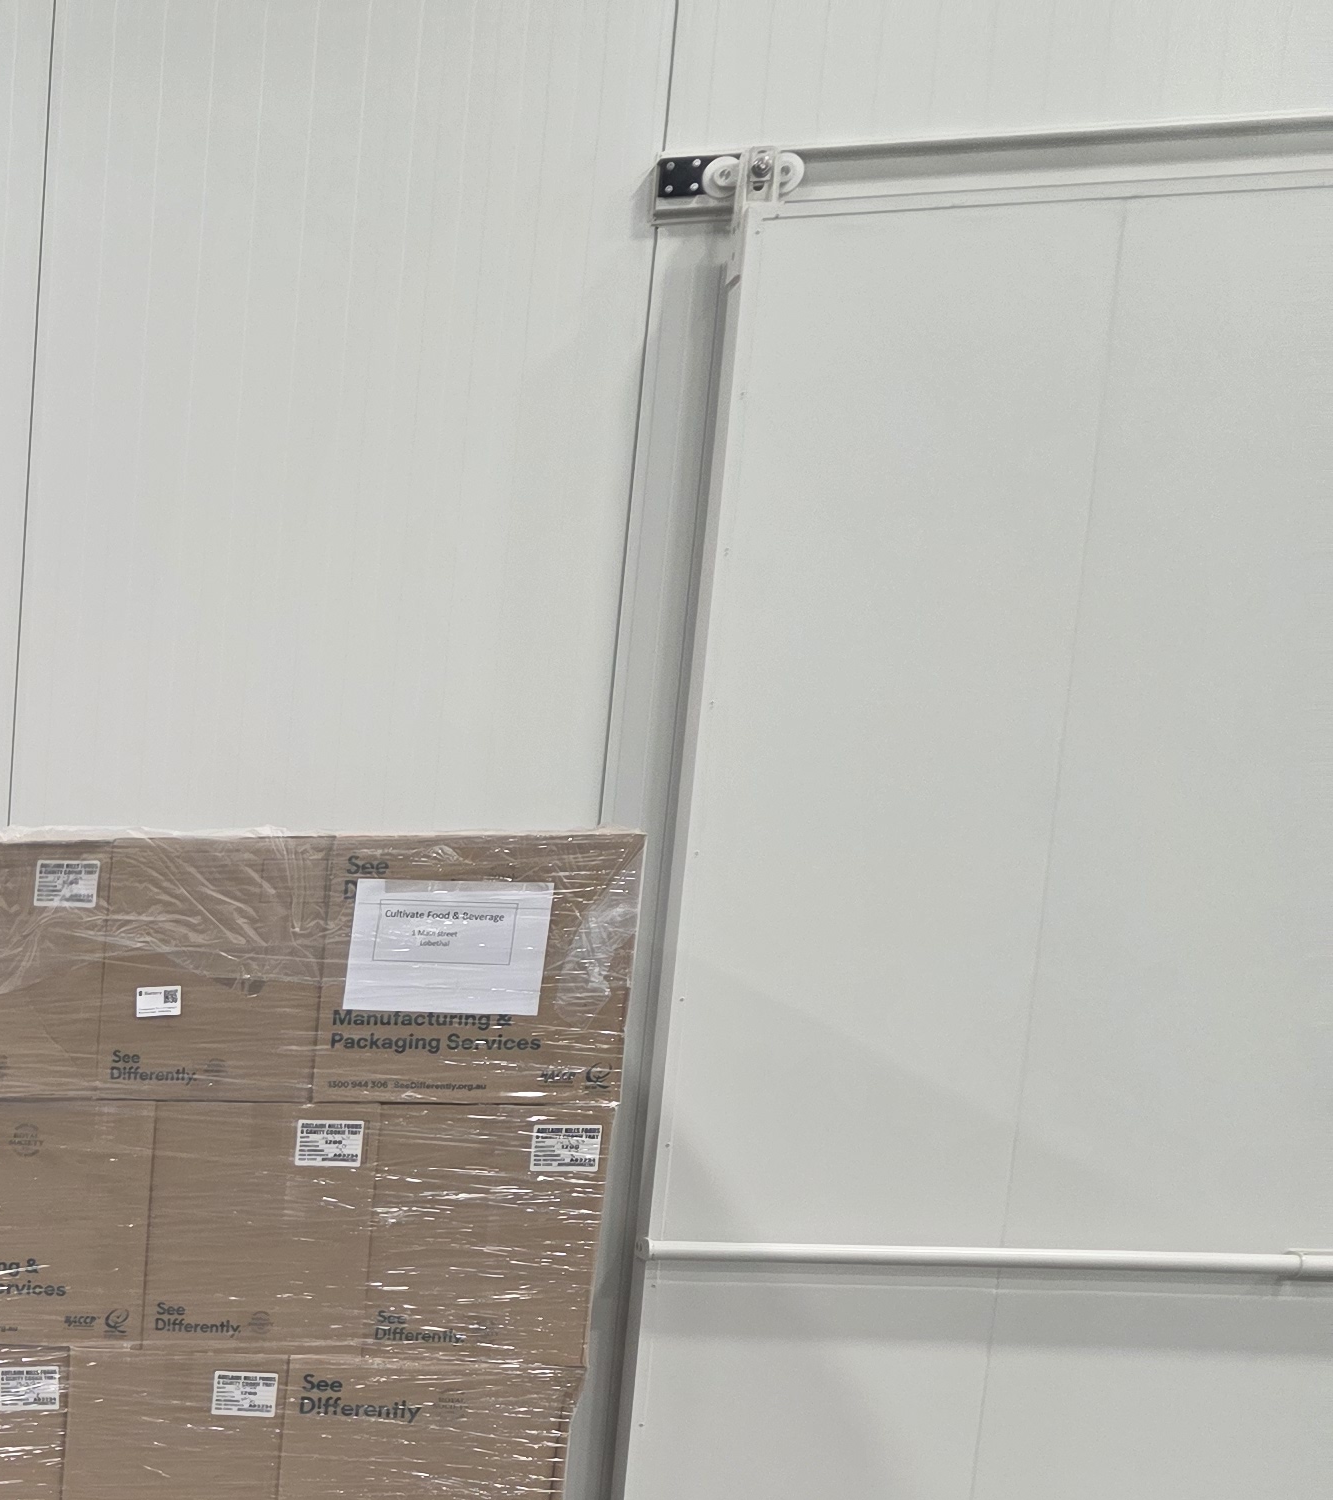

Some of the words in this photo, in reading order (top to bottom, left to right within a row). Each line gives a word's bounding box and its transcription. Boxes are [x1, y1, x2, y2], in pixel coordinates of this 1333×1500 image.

[346, 856, 390, 875] See
[385, 909, 425, 920] Cultivate
[427, 910, 450, 921] Food
[452, 911, 459, 921] &
[462, 911, 505, 922] Beverage
[437, 929, 458, 938] street
[420, 939, 451, 948] Lobethal
[333, 1009, 491, 1030] Manufacturing
[497, 1013, 513, 1027] &
[331, 1032, 440, 1054] Packaging
[447, 1033, 541, 1051] Services
[112, 1050, 140, 1064] See
[350, 1080, 369, 1090] 944
[370, 1080, 388, 1090] 306
[25, 1258, 39, 1274] &
[156, 1302, 186, 1315] See
[377, 1310, 406, 1324] See
[302, 1373, 343, 1392] See
